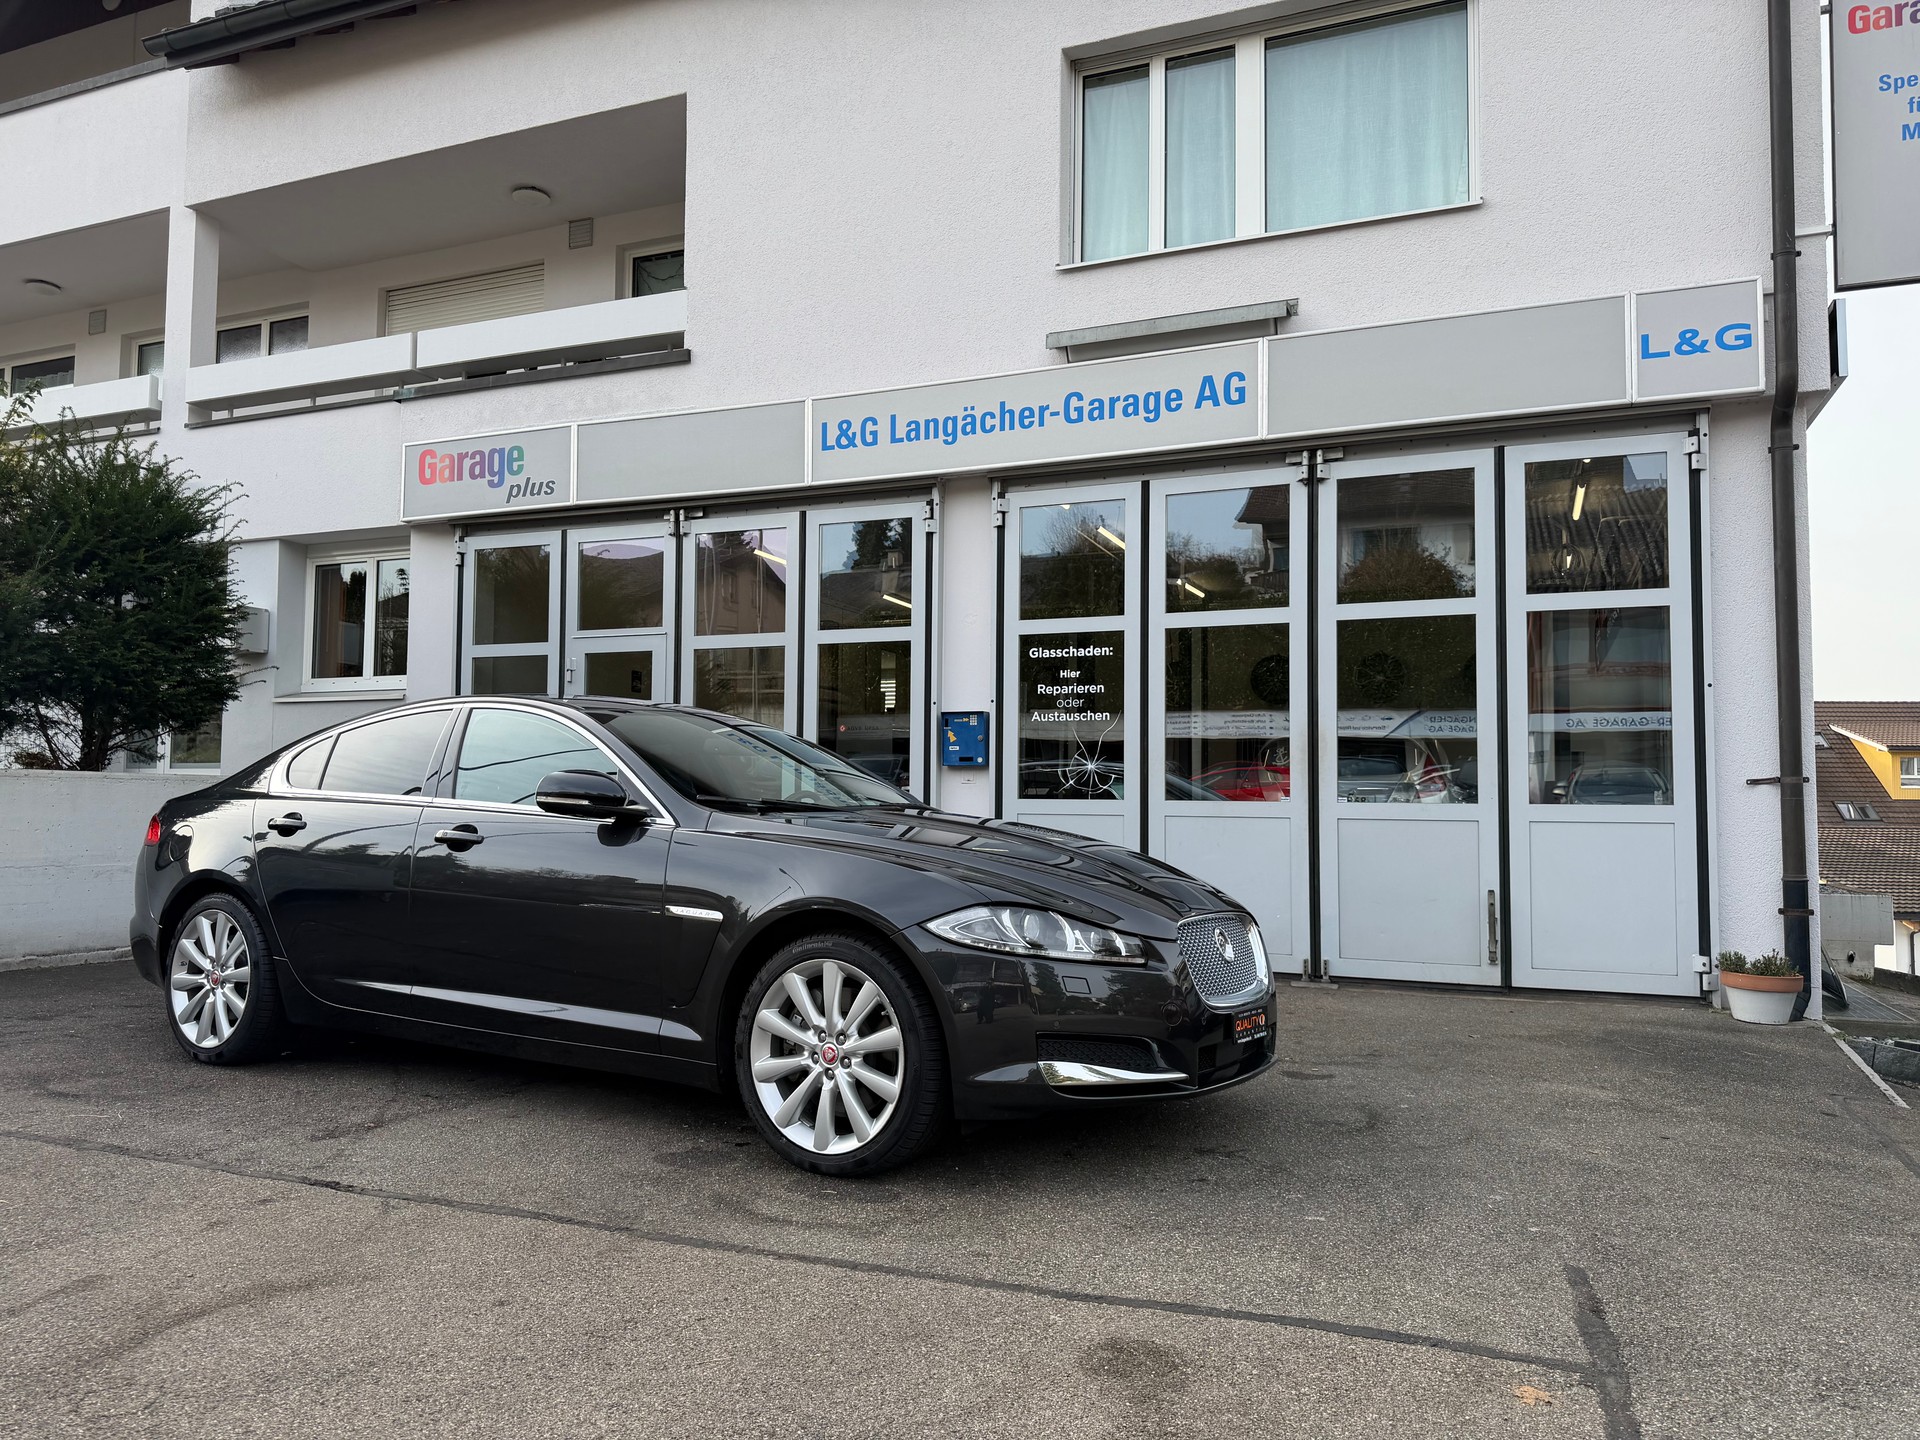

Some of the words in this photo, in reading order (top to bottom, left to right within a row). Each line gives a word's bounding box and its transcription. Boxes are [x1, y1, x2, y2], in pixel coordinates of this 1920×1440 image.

[1640, 322, 1753, 360] L&G
[820, 416, 879, 452] L&G
[890, 391, 1183, 446] Langächer-Garage
[1194, 371, 1247, 410] AG
[418, 445, 525, 488] Garage
[505, 476, 556, 504] plus
[1029, 645, 1114, 659] Glasschaden:
[1059, 669, 1081, 679] Hier
[1037, 683, 1105, 696] Reparieren
[1056, 697, 1085, 707] oder
[1031, 711, 1110, 722] Austauschen
